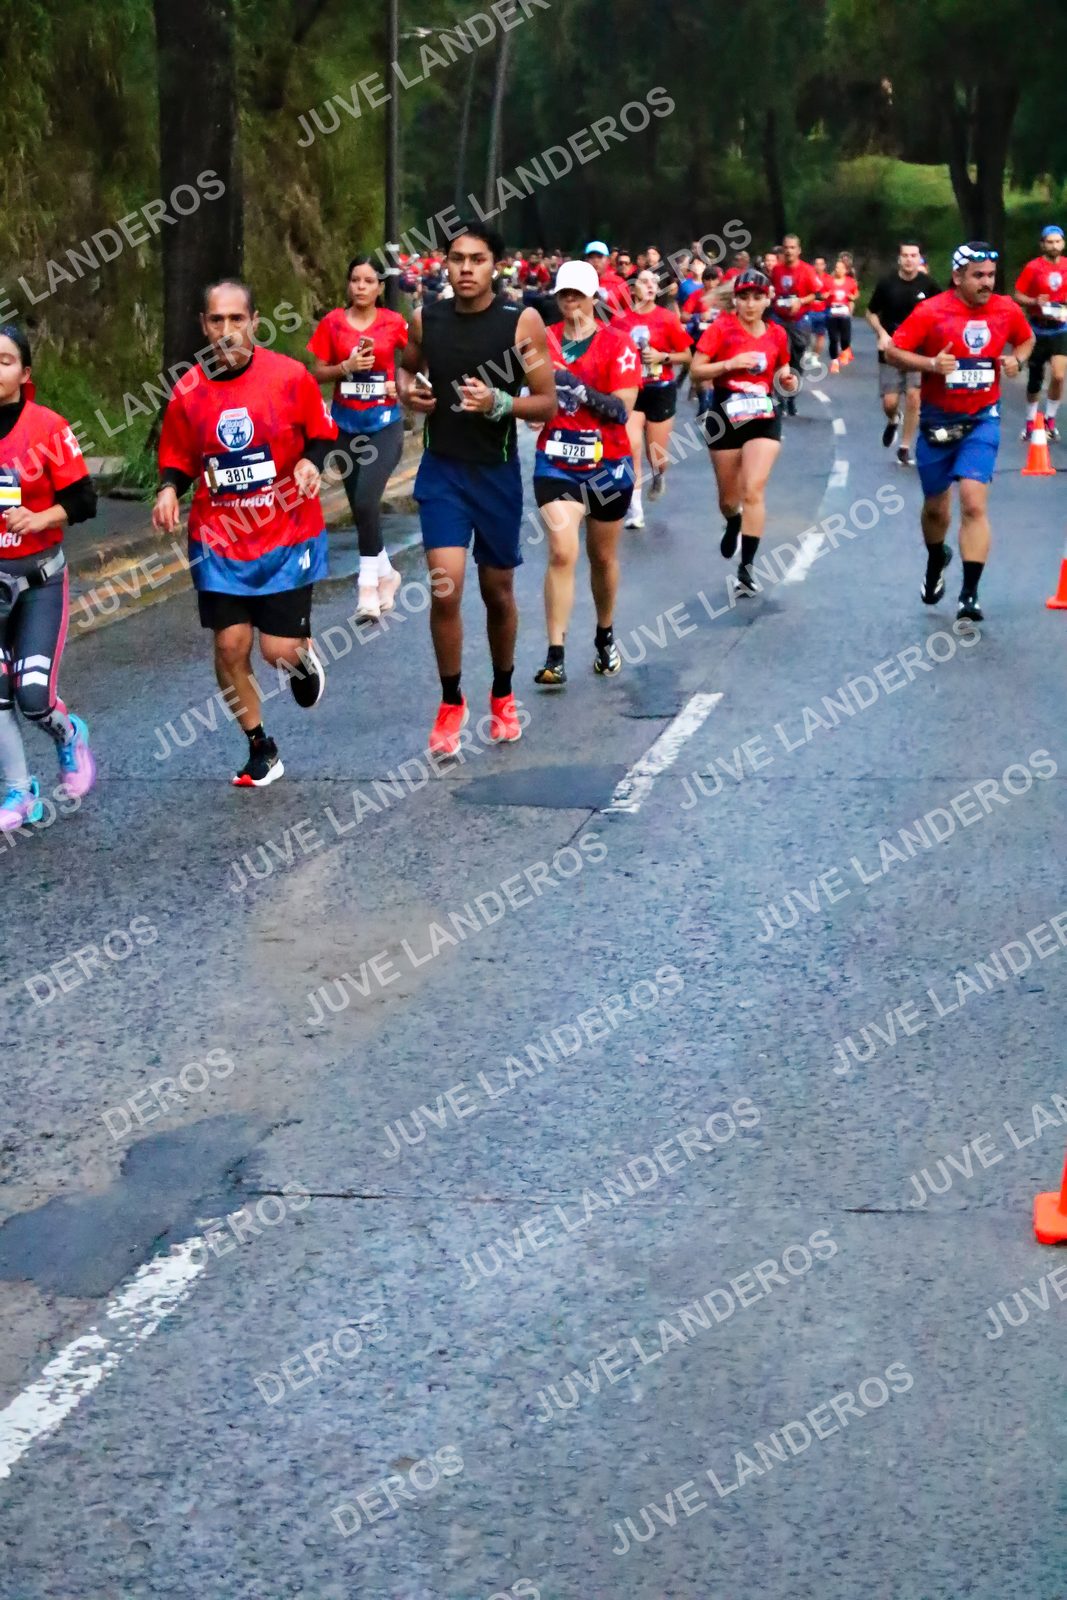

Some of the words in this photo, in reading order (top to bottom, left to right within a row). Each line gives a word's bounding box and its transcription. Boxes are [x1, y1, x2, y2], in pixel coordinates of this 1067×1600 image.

[356, 384, 376, 393] 5702
[562, 445, 586, 456] 5728
[226, 467, 254, 483] 3814
